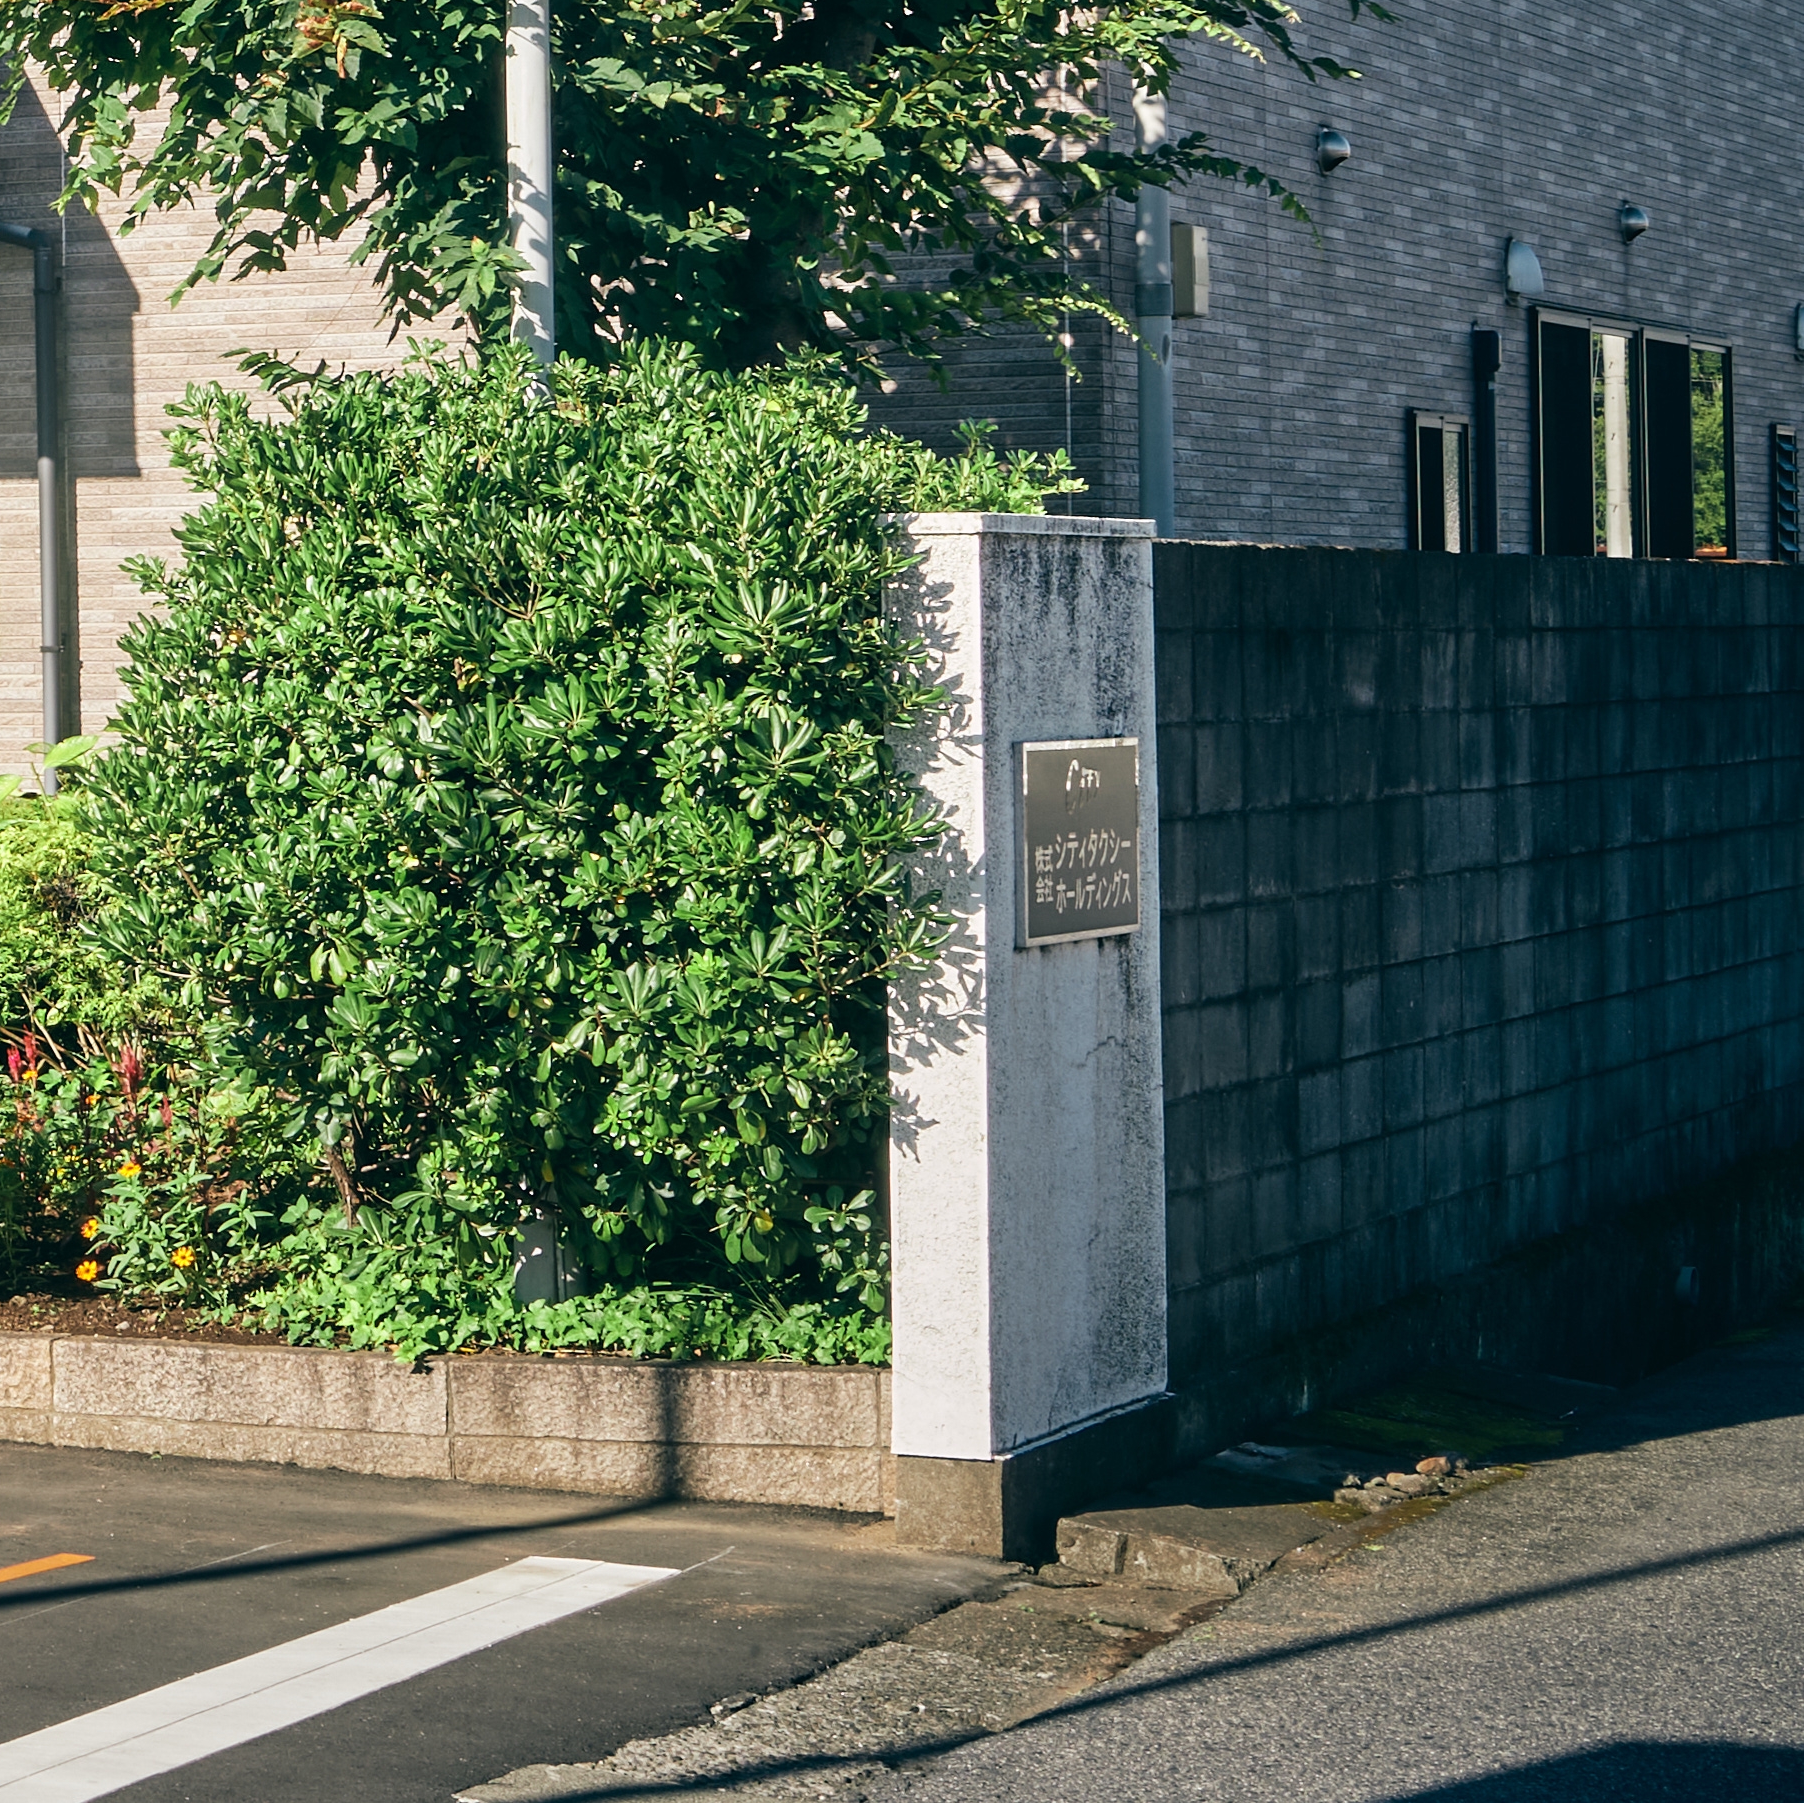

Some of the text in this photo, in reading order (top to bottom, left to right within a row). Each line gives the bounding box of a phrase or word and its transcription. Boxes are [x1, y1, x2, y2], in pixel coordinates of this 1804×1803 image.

[1055, 828, 1131, 870] シティタクシー
[1056, 868, 1132, 915] ホールディングス
